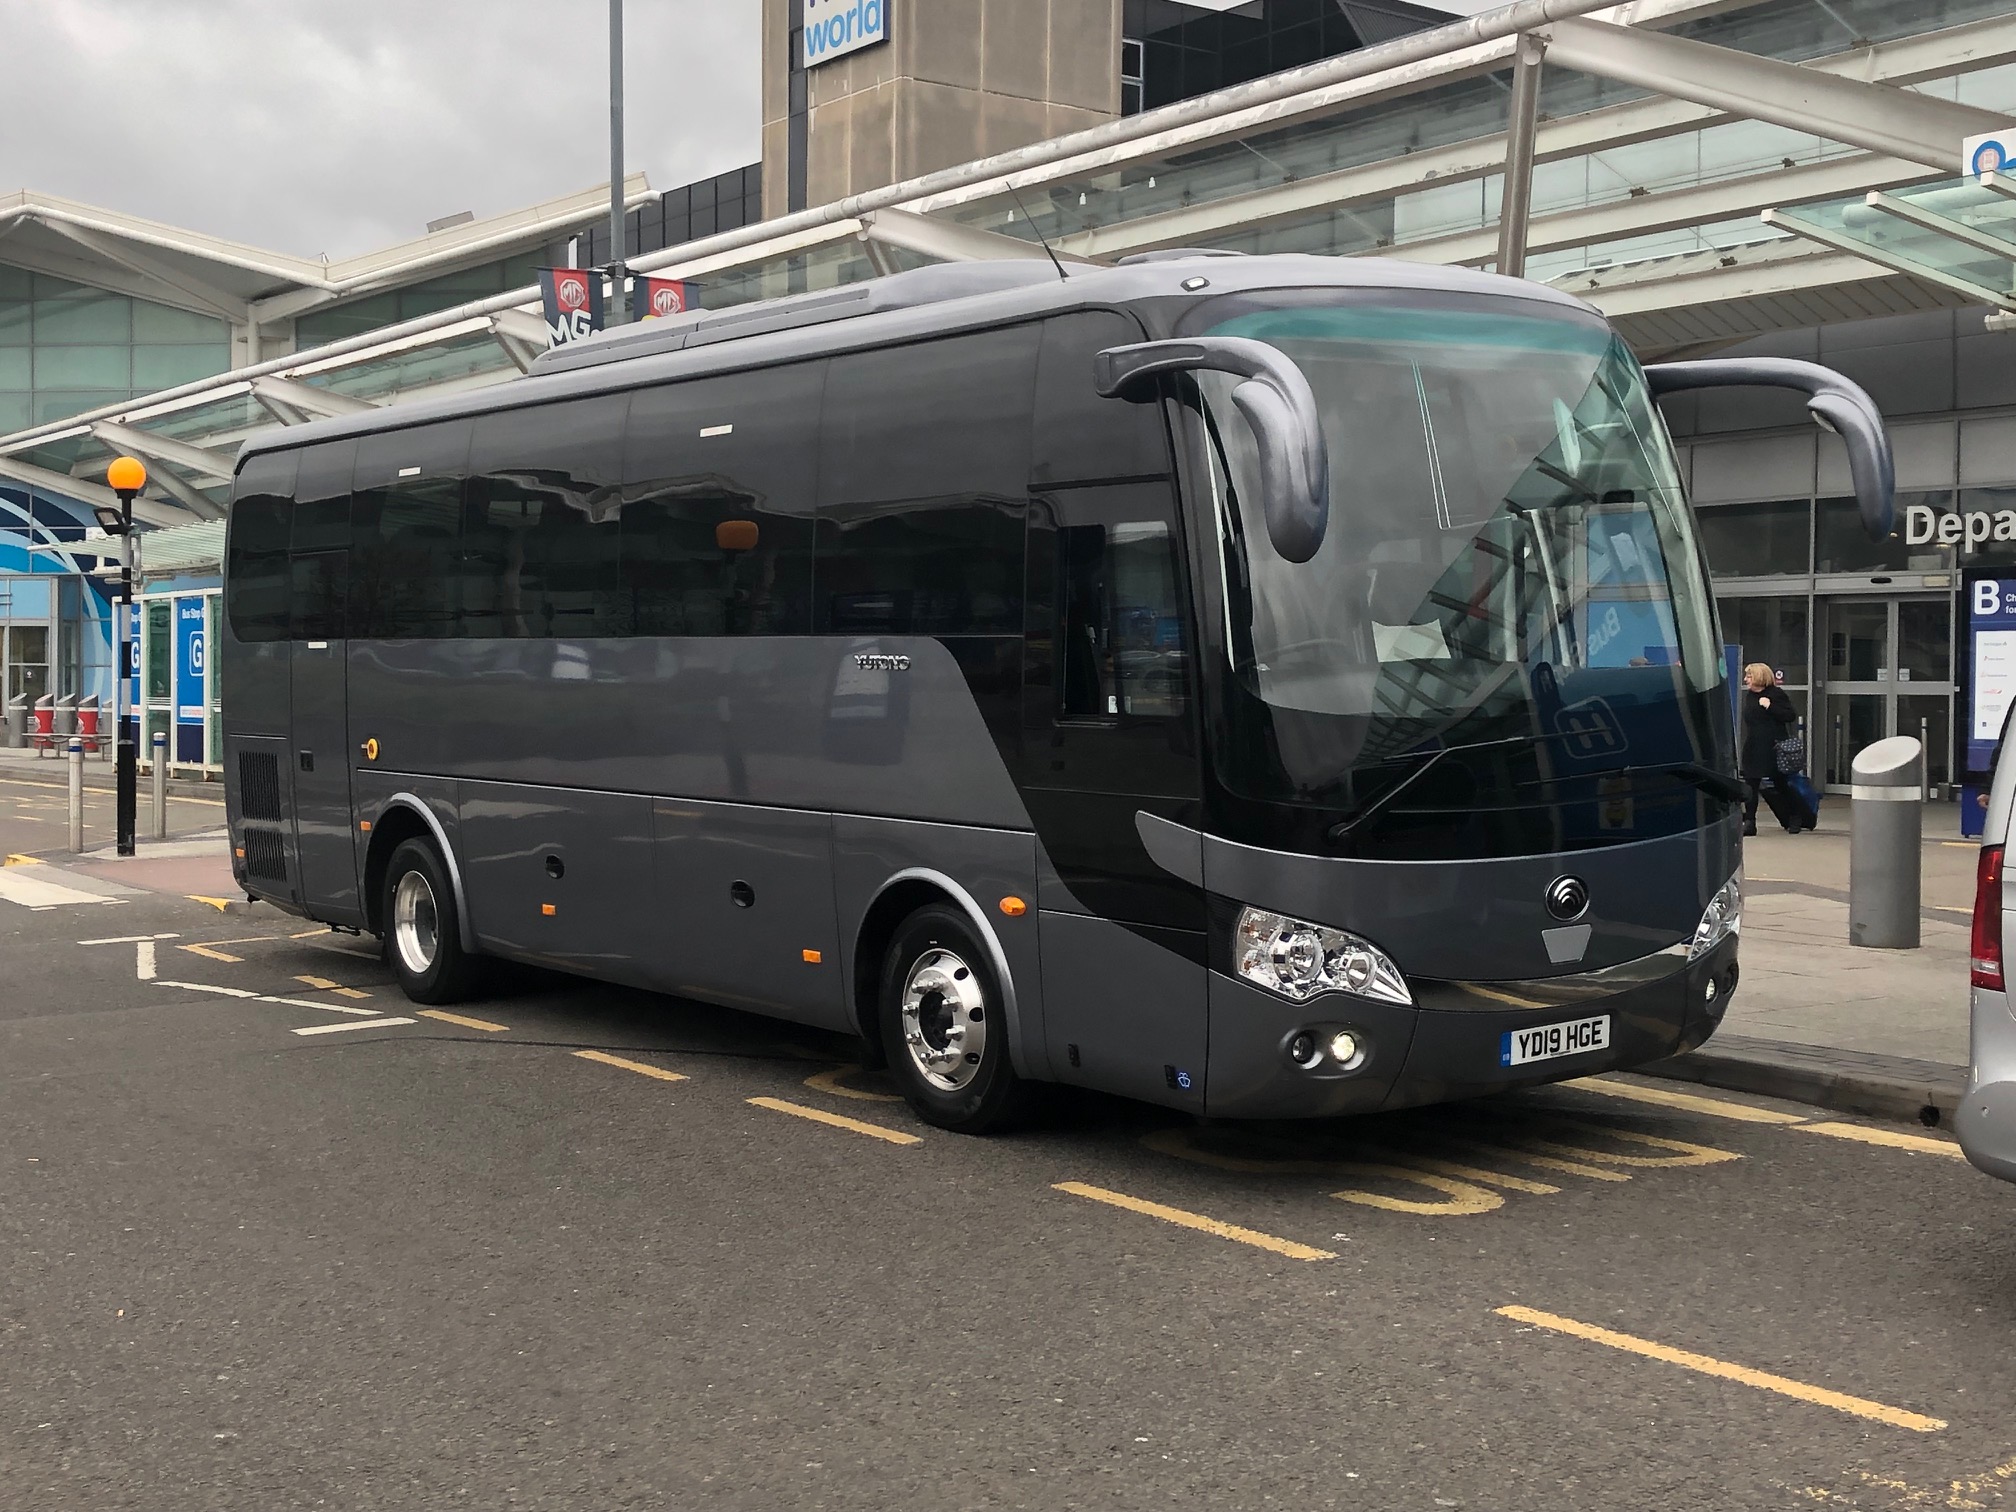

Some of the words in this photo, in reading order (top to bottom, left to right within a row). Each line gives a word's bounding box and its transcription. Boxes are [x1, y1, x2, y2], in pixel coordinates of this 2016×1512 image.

[805, 0, 881, 57] world
[561, 281, 584, 305] MG
[656, 291, 679, 314] MG
[1906, 505, 2016, 553] Depa
[1975, 580, 2001, 615] B
[192, 639, 202, 668] G
[854, 653, 911, 671] YUTONG
[1519, 1028, 1561, 1058] YD19
[1566, 1020, 1603, 1050] HGE
